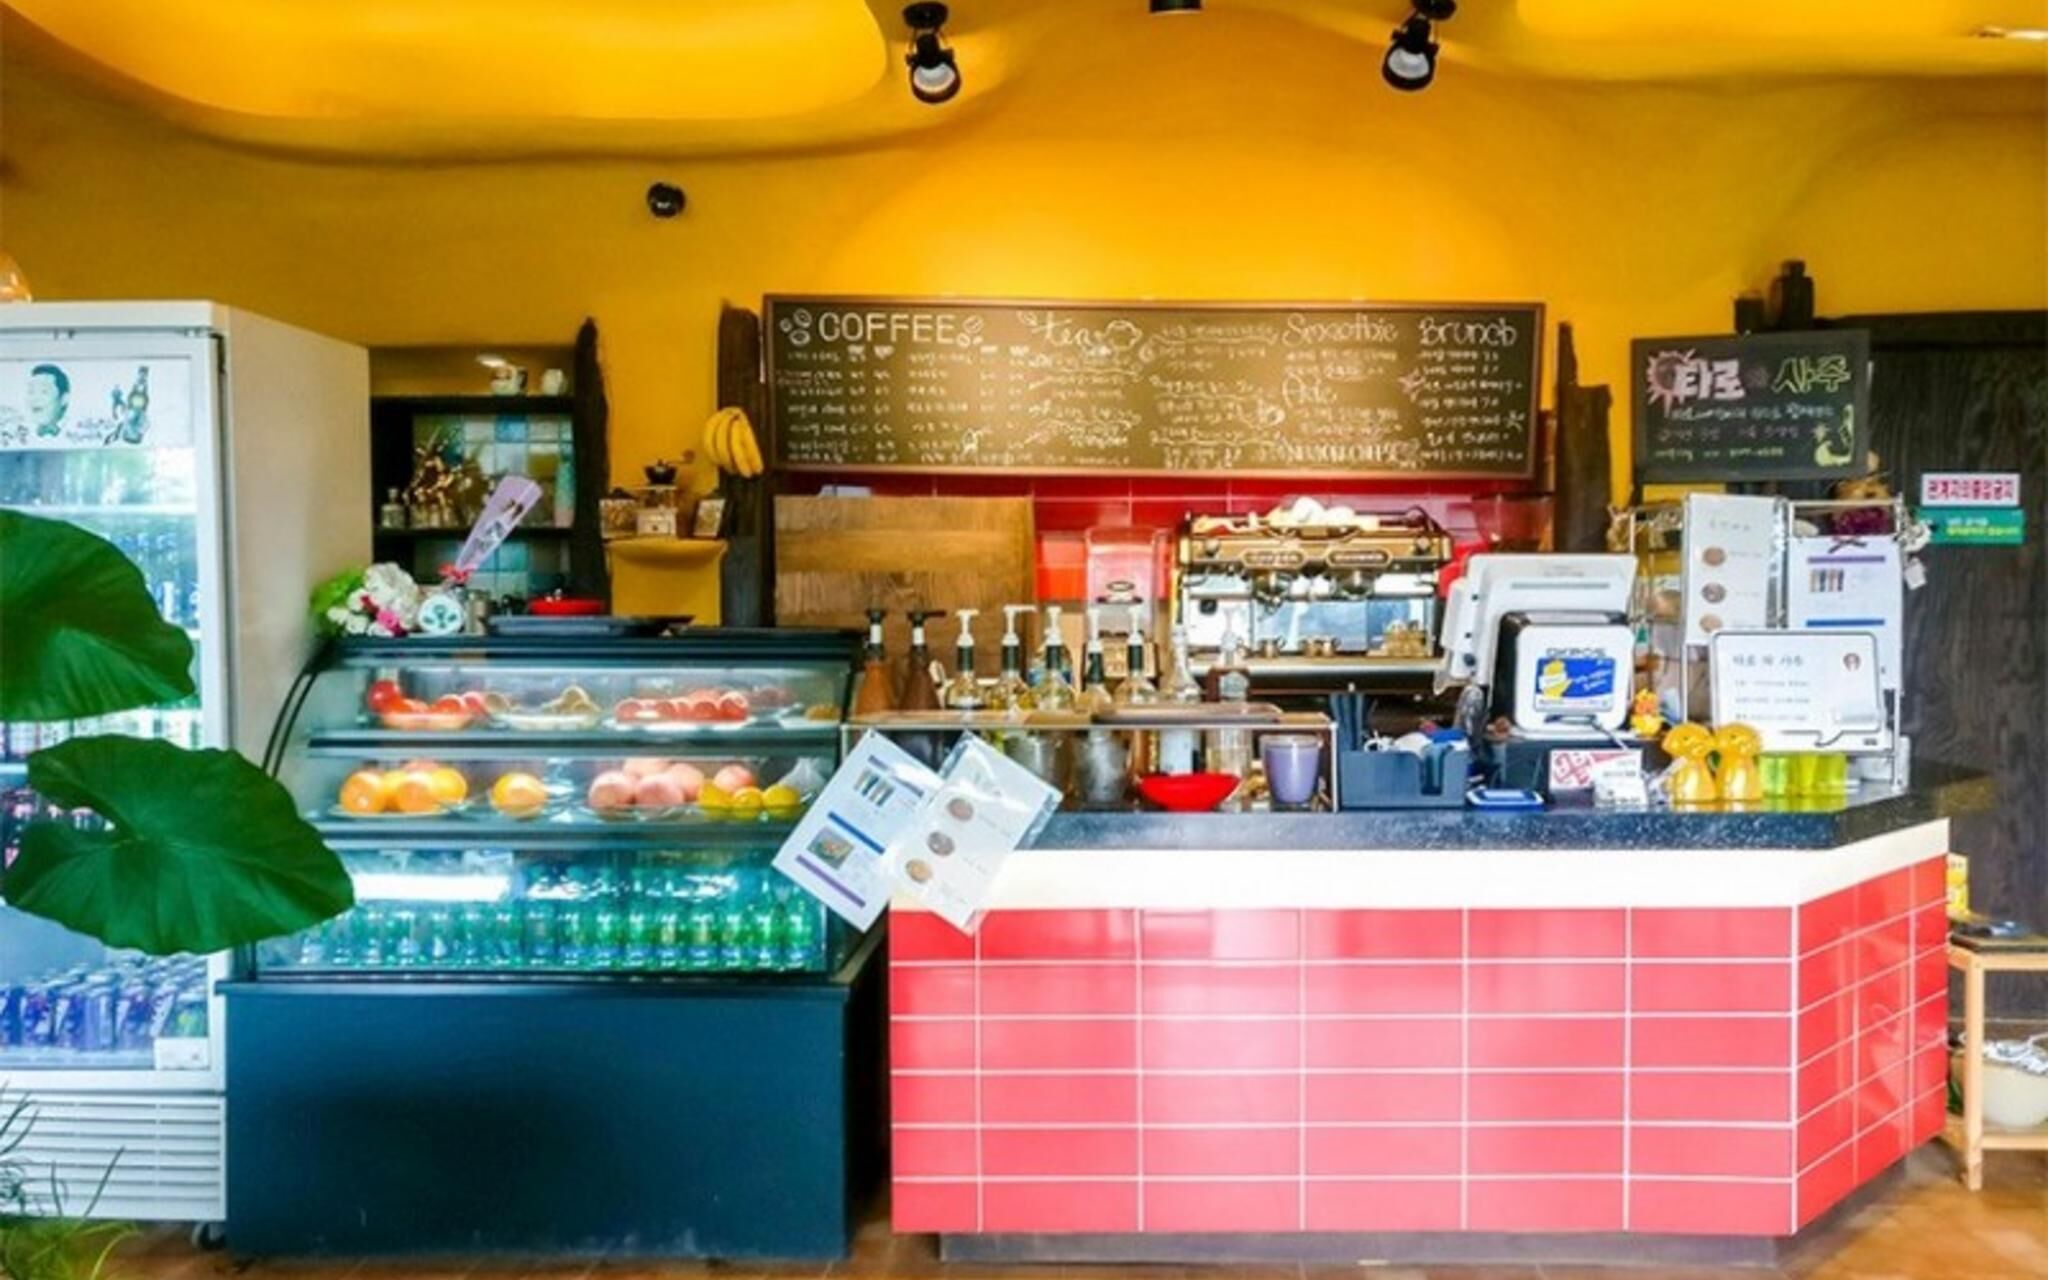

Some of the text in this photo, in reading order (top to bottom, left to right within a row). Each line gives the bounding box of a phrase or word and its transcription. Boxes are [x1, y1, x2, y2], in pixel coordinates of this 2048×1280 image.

[818, 311, 956, 343] COFFEE
[1031, 312, 1103, 347] tea
[1282, 312, 1399, 347] Smoothie
[1418, 317, 1517, 347] Brunch
[1676, 357, 1745, 401] 타로
[1771, 355, 1852, 394] 사주
